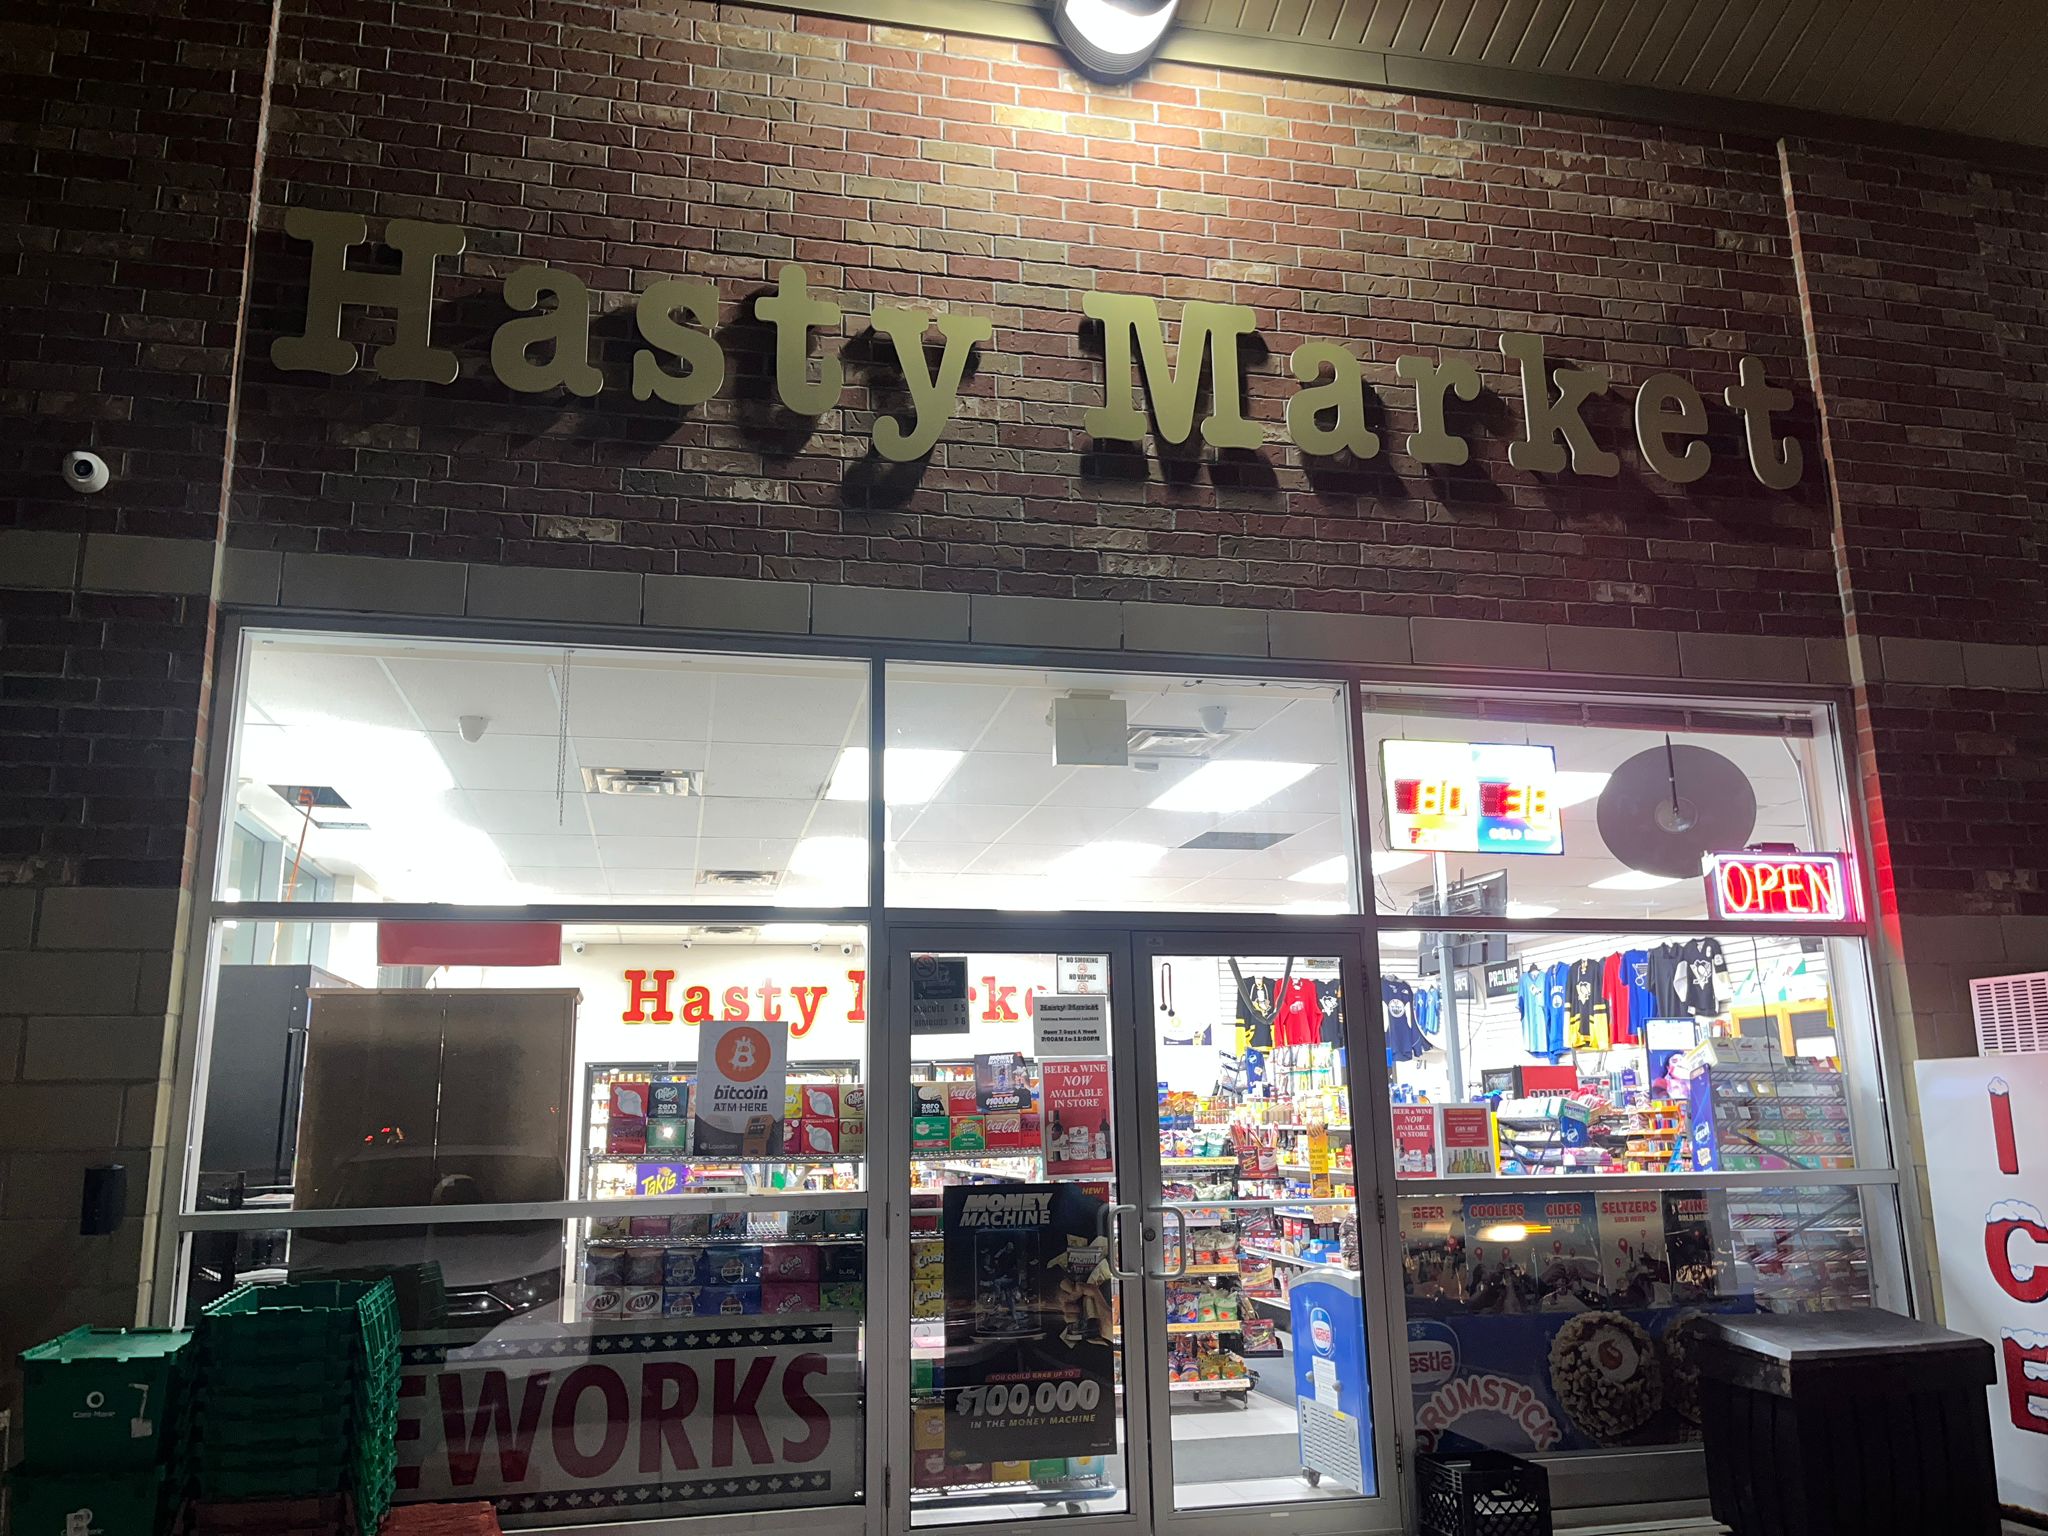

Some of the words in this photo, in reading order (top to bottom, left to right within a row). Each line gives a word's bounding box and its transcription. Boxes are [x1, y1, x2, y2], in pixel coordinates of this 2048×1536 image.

[270, 207, 992, 462] Hasty
[1082, 292, 1803, 490] Market
[1722, 861, 1839, 913] OPEN
[622, 969, 828, 1038] Hasty
[1040, 1004, 1066, 1012] Hasty
[1044, 1065, 1070, 1074] BEER
[1080, 1064, 1106, 1072] WINE
[1063, 1075, 1092, 1086] NOW
[714, 1085, 768, 1100] bitcoin
[1050, 1088, 1103, 1098] AVAILABLE
[713, 1103, 737, 1112] ATM
[739, 1103, 768, 1112] HERE
[1054, 1100, 1065, 1108] IN
[1067, 1099, 1099, 1107] STORE
[1405, 1115, 1424, 1123] NOW
[963, 1193, 1053, 1212] MONEY
[1546, 1202, 1582, 1216] CIDER
[1602, 1200, 1657, 1214] SELTZERS
[1679, 1199, 1709, 1214] WINE
[1413, 1206, 1444, 1219] BEER
[1471, 1203, 1525, 1217] COOLERS
[959, 1210, 1050, 1227] MACHINE
[1409, 1350, 1453, 1374] estlé
[956, 1380, 1100, 1417] $100,000
[396, 1352, 831, 1489] EWORKS
[970, 1421, 982, 1429] IN
[986, 1419, 1005, 1428] THE
[1009, 1417, 1046, 1427] MONEY
[1049, 1414, 1096, 1424] MACHINE
